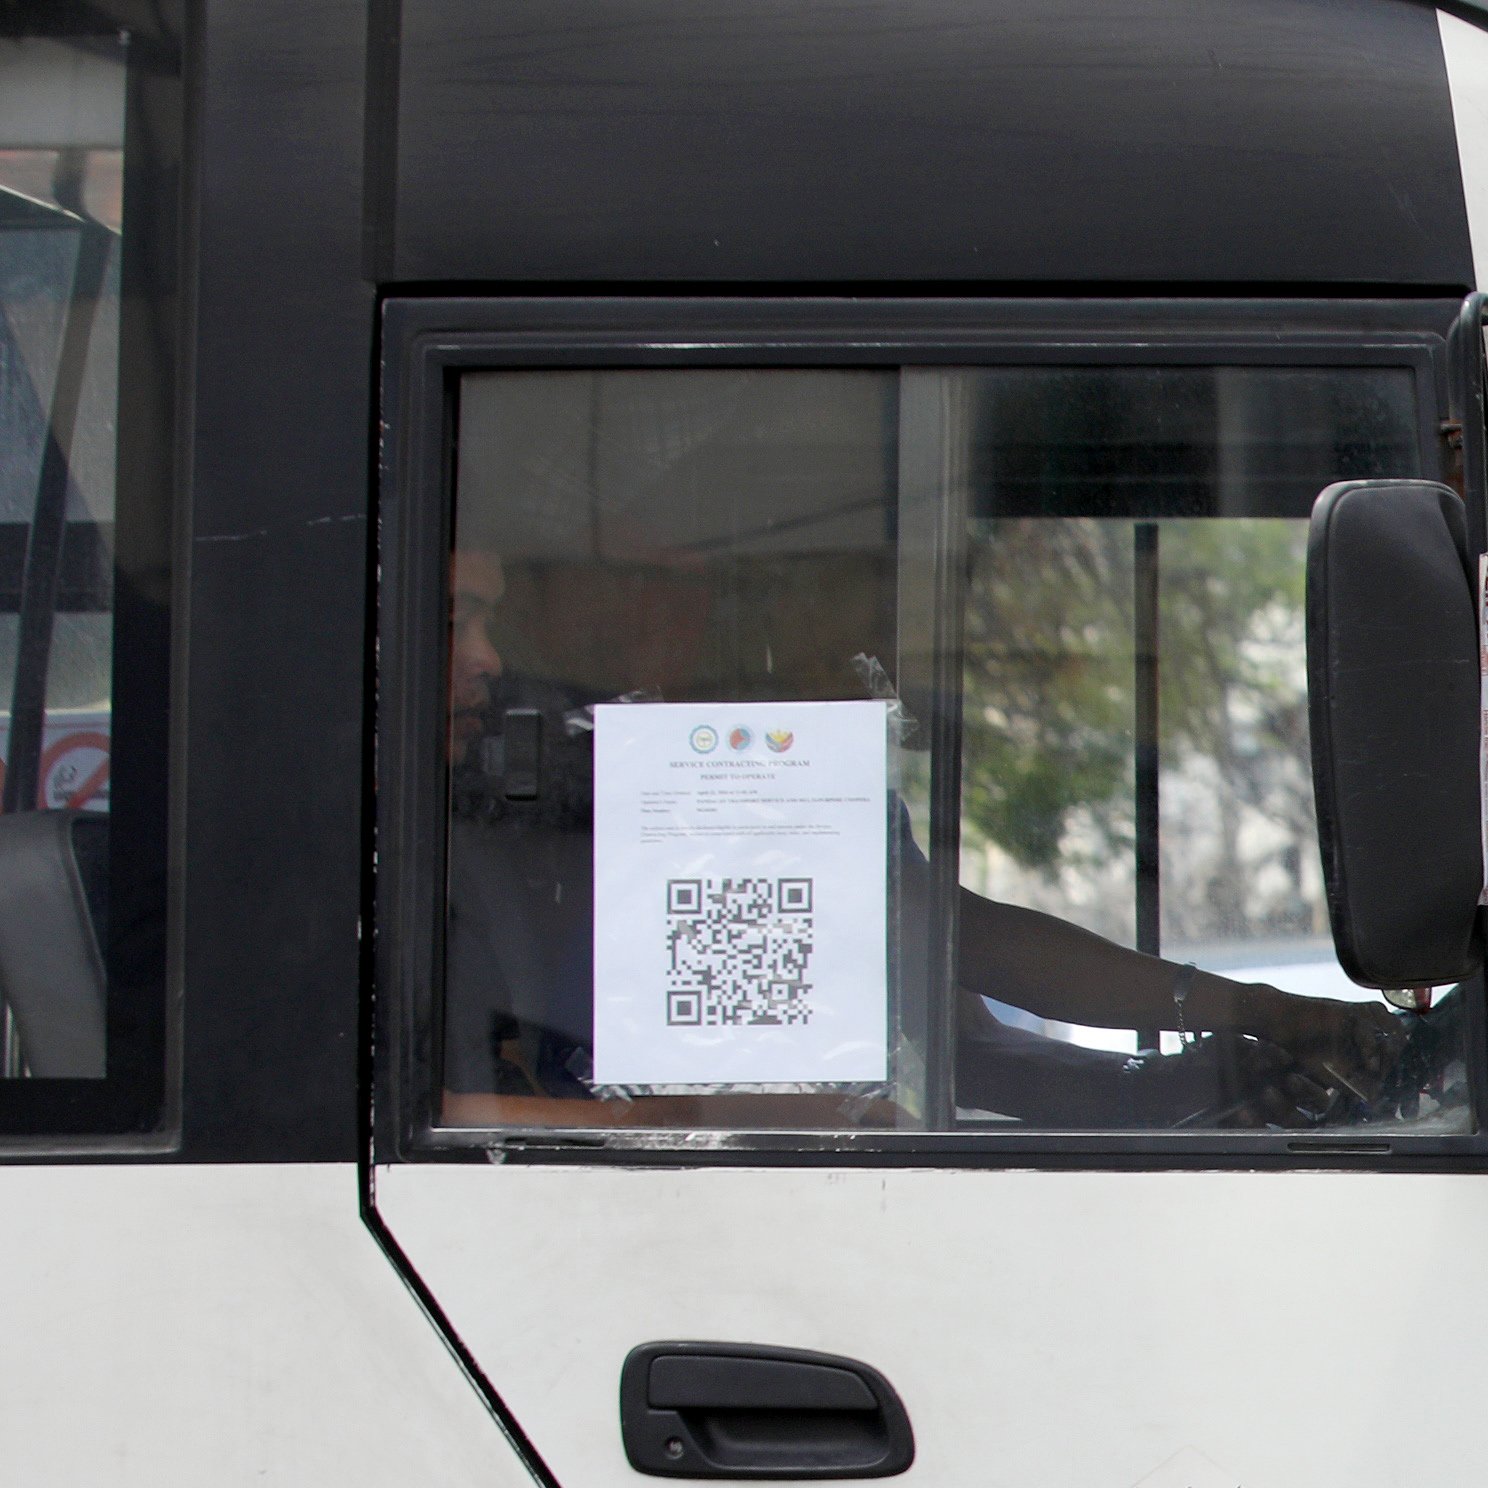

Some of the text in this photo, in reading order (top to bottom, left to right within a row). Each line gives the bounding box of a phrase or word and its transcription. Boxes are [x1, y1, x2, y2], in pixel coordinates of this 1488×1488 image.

[669, 760, 811, 769] SERVICE CONTRACTING PROGRAM
